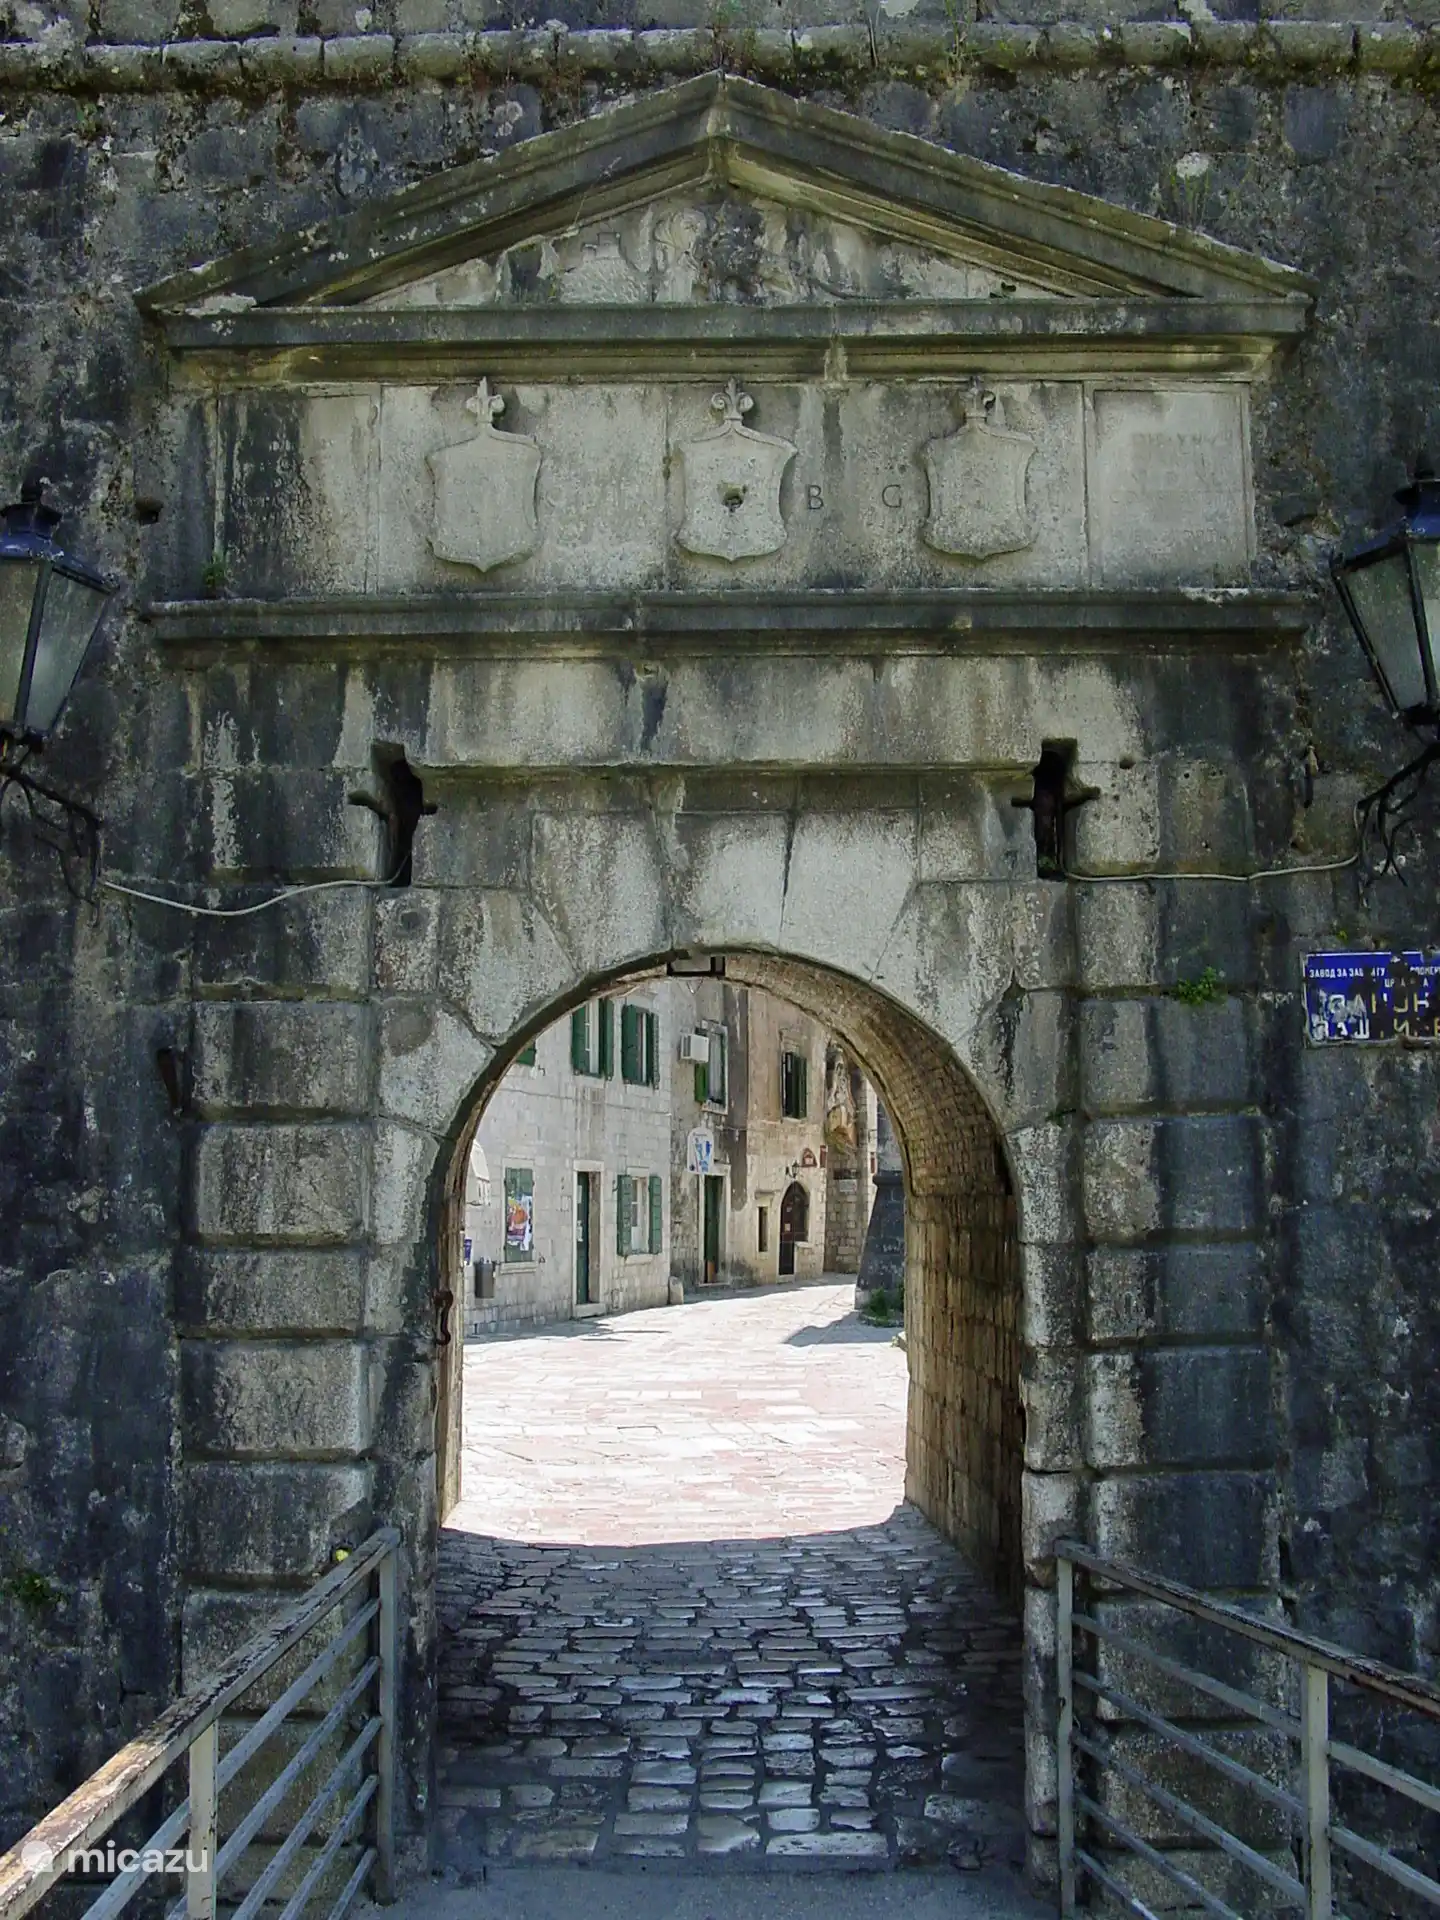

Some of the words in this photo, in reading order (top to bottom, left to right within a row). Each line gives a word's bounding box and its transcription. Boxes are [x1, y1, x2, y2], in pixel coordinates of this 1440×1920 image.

[808, 484, 824, 510] B
[881, 484, 902, 508] G
[1309, 968, 1336, 979] ЗАВОД
[1336, 967, 1348, 978] ЗА
